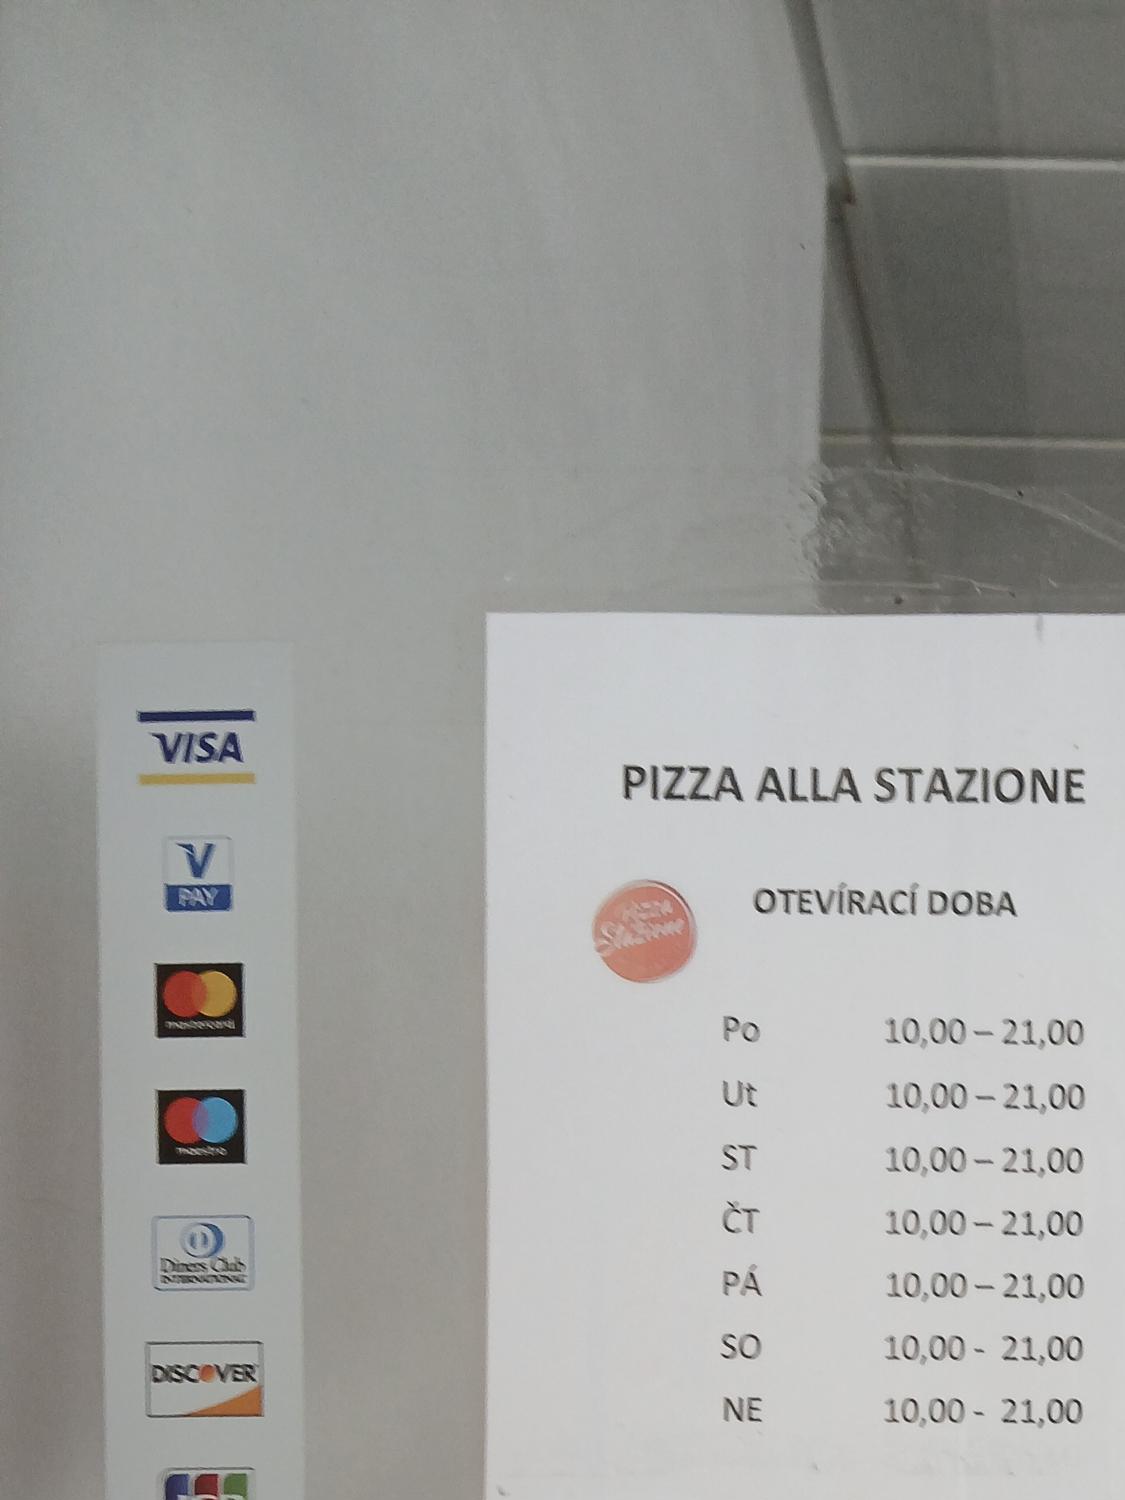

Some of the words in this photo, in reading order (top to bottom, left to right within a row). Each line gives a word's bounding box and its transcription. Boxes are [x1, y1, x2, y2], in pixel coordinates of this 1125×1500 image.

[149, 731, 245, 764] VISA
[622, 763, 745, 803] PIZZA
[754, 766, 863, 804] ALLA
[873, 766, 1086, 805] STAZIONE
[175, 842, 216, 879] V
[177, 887, 219, 908] PAY
[752, 881, 920, 917] OTEVÍRACÍ
[926, 889, 1019, 918] DOBA
[722, 1015, 761, 1044] Po
[884, 1016, 967, 1050] 10,00
[1001, 1018, 1085, 1051] 21,00
[886, 1081, 969, 1114] 10,00
[1002, 1082, 1086, 1115] 21,00
[720, 1143, 758, 1172] ST
[885, 1145, 968, 1178] 10,00
[1001, 1146, 1085, 1179] 21,00
[721, 1200, 761, 1235] ČT
[885, 1208, 967, 1241] 10,00
[1001, 1209, 1084, 1242] 21,00
[211, 1257, 246, 1273] Club
[722, 1263, 764, 1297] PÁ
[886, 1271, 969, 1303] 10,00
[1002, 1272, 1085, 1304] 21,00
[719, 1332, 763, 1361] SO
[884, 1334, 966, 1366] 10,00
[1001, 1334, 1085, 1367] 21,00
[151, 1364, 258, 1383] DISCOVER
[722, 1396, 763, 1423] NE
[883, 1397, 966, 1429] 10,00
[1000, 1397, 1084, 1429] 21,00
